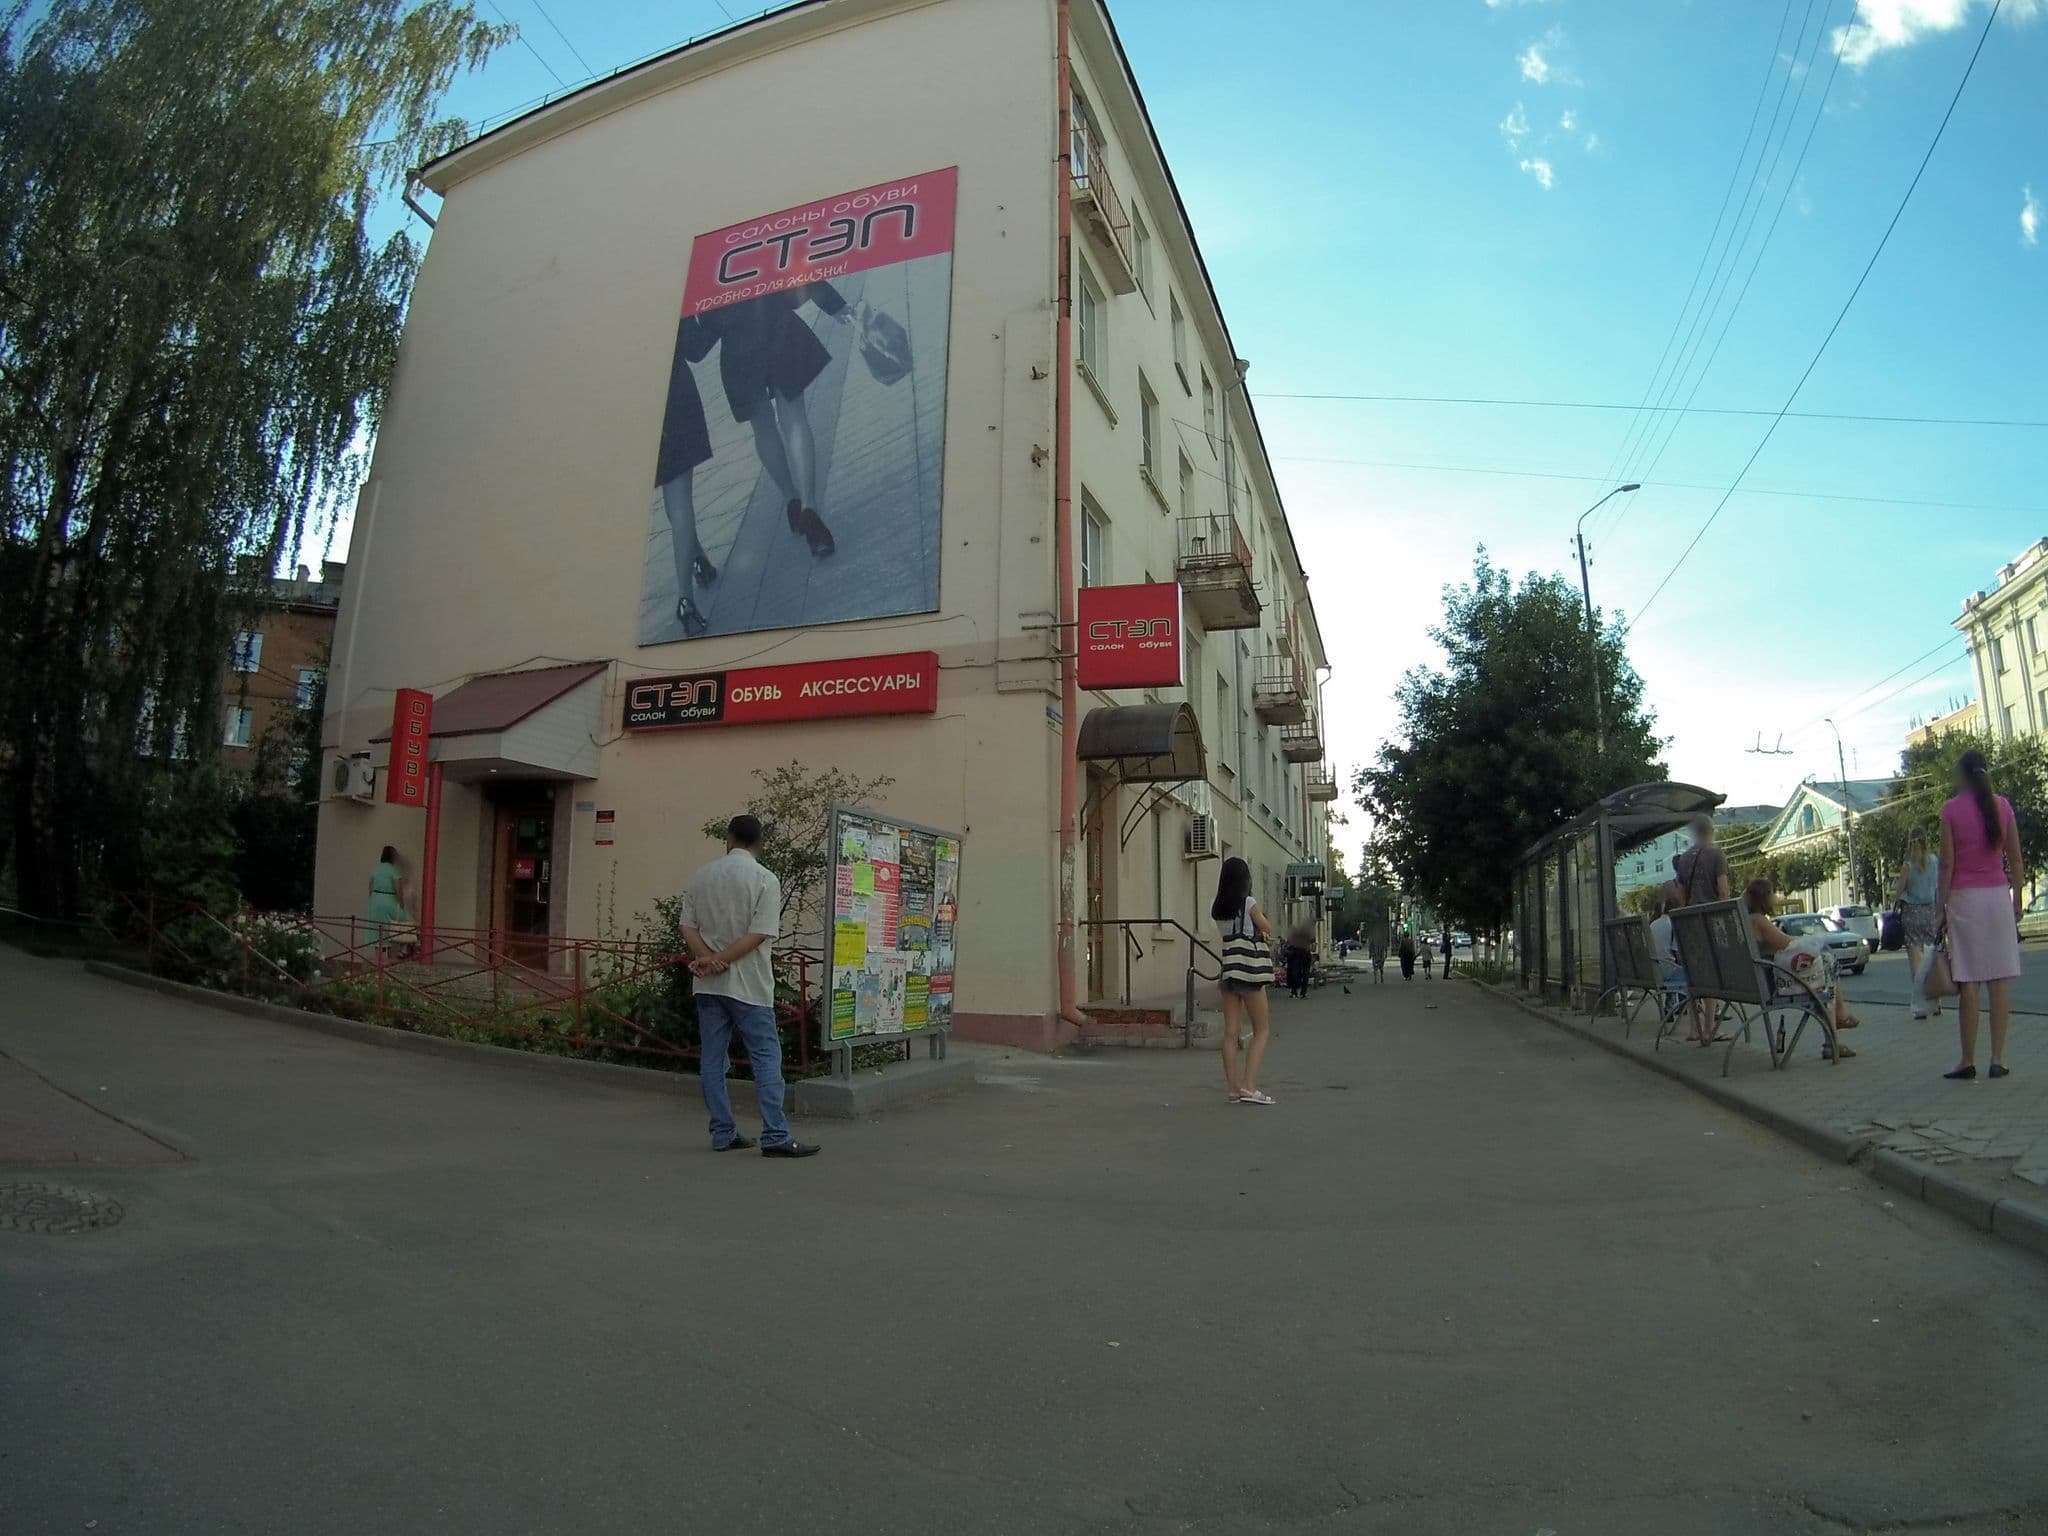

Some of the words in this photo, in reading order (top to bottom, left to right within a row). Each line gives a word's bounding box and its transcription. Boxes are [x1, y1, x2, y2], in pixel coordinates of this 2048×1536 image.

[725, 207, 826, 245] салоны
[833, 184, 918, 214] обуви
[717, 203, 916, 285] СТЭП
[1088, 618, 1172, 640] СТЭП
[1090, 643, 1125, 651] салон
[1138, 641, 1173, 649] обуви
[630, 679, 718, 711] СТЭП
[731, 683, 782, 703] ОБУВЬ
[800, 672, 921, 698] АКСЕССУАРЫ
[630, 710, 666, 722] салон
[680, 707, 716, 720] обуви
[404, 700, 426, 797] ОБУВЬ
